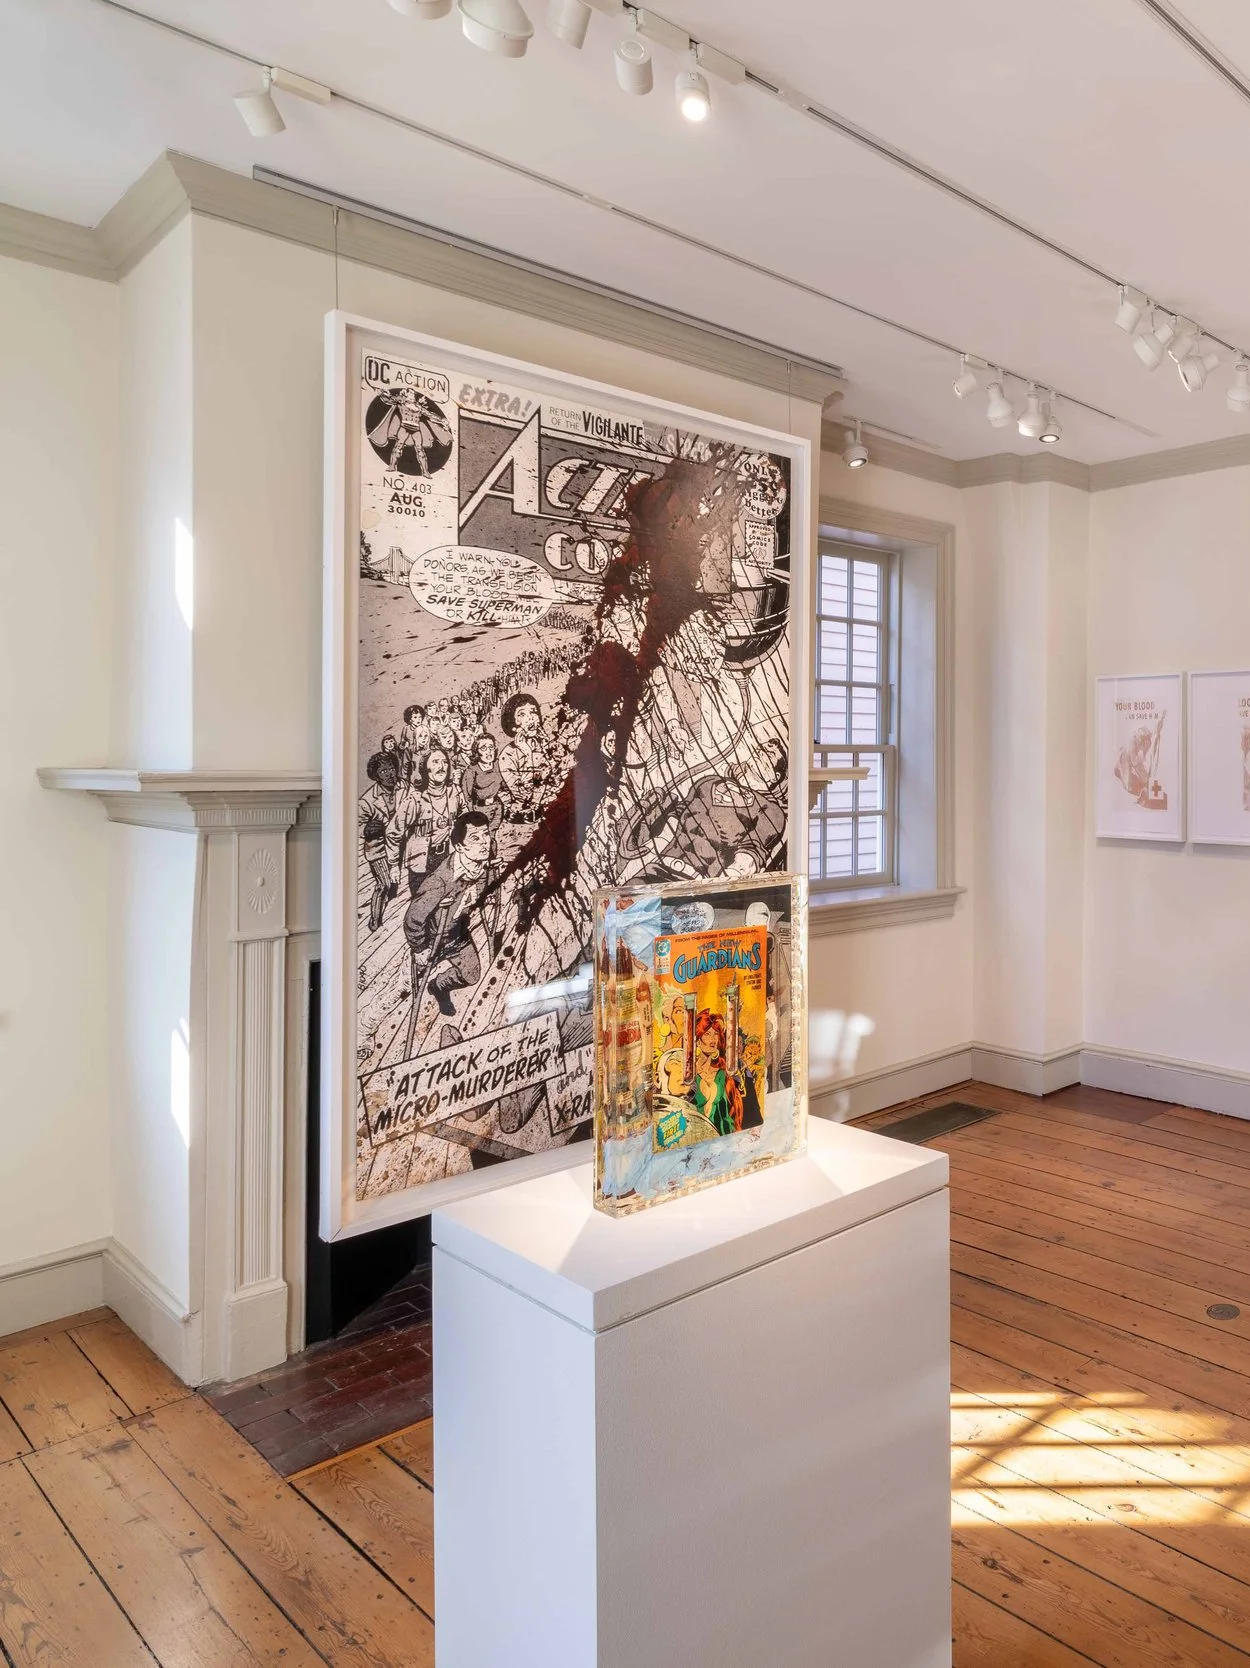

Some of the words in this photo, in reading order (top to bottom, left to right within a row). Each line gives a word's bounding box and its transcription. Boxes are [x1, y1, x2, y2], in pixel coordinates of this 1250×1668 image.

[368, 359, 391, 385] DC
[395, 370, 447, 394] ACTION
[458, 383, 533, 418] EXTRA!
[549, 406, 582, 422] RETURN
[551, 416, 563, 426] OF
[566, 420, 580, 431] THE
[582, 410, 644, 446] VIGILANTE
[411, 482, 432, 495] 403
[389, 491, 426, 509] AUG.
[387, 504, 426, 518] 30010
[446, 549, 454, 560] I
[431, 572, 454, 583] THE
[460, 575, 538, 593] TRANSFUSION
[472, 566, 486, 576] AS
[509, 570, 542, 582] BEGIN
[430, 584, 461, 595] YOUR
[466, 587, 510, 599] BLOOD
[426, 594, 467, 607] SAVE
[468, 599, 543, 615] SUPERMAN
[445, 609, 463, 619] OR
[1134, 701, 1155, 711] BLOOD
[673, 942, 762, 984] GUARDIANS
[486, 1041, 512, 1063] OF
[518, 1028, 551, 1051] THE
[556, 1049, 589, 1094] and
